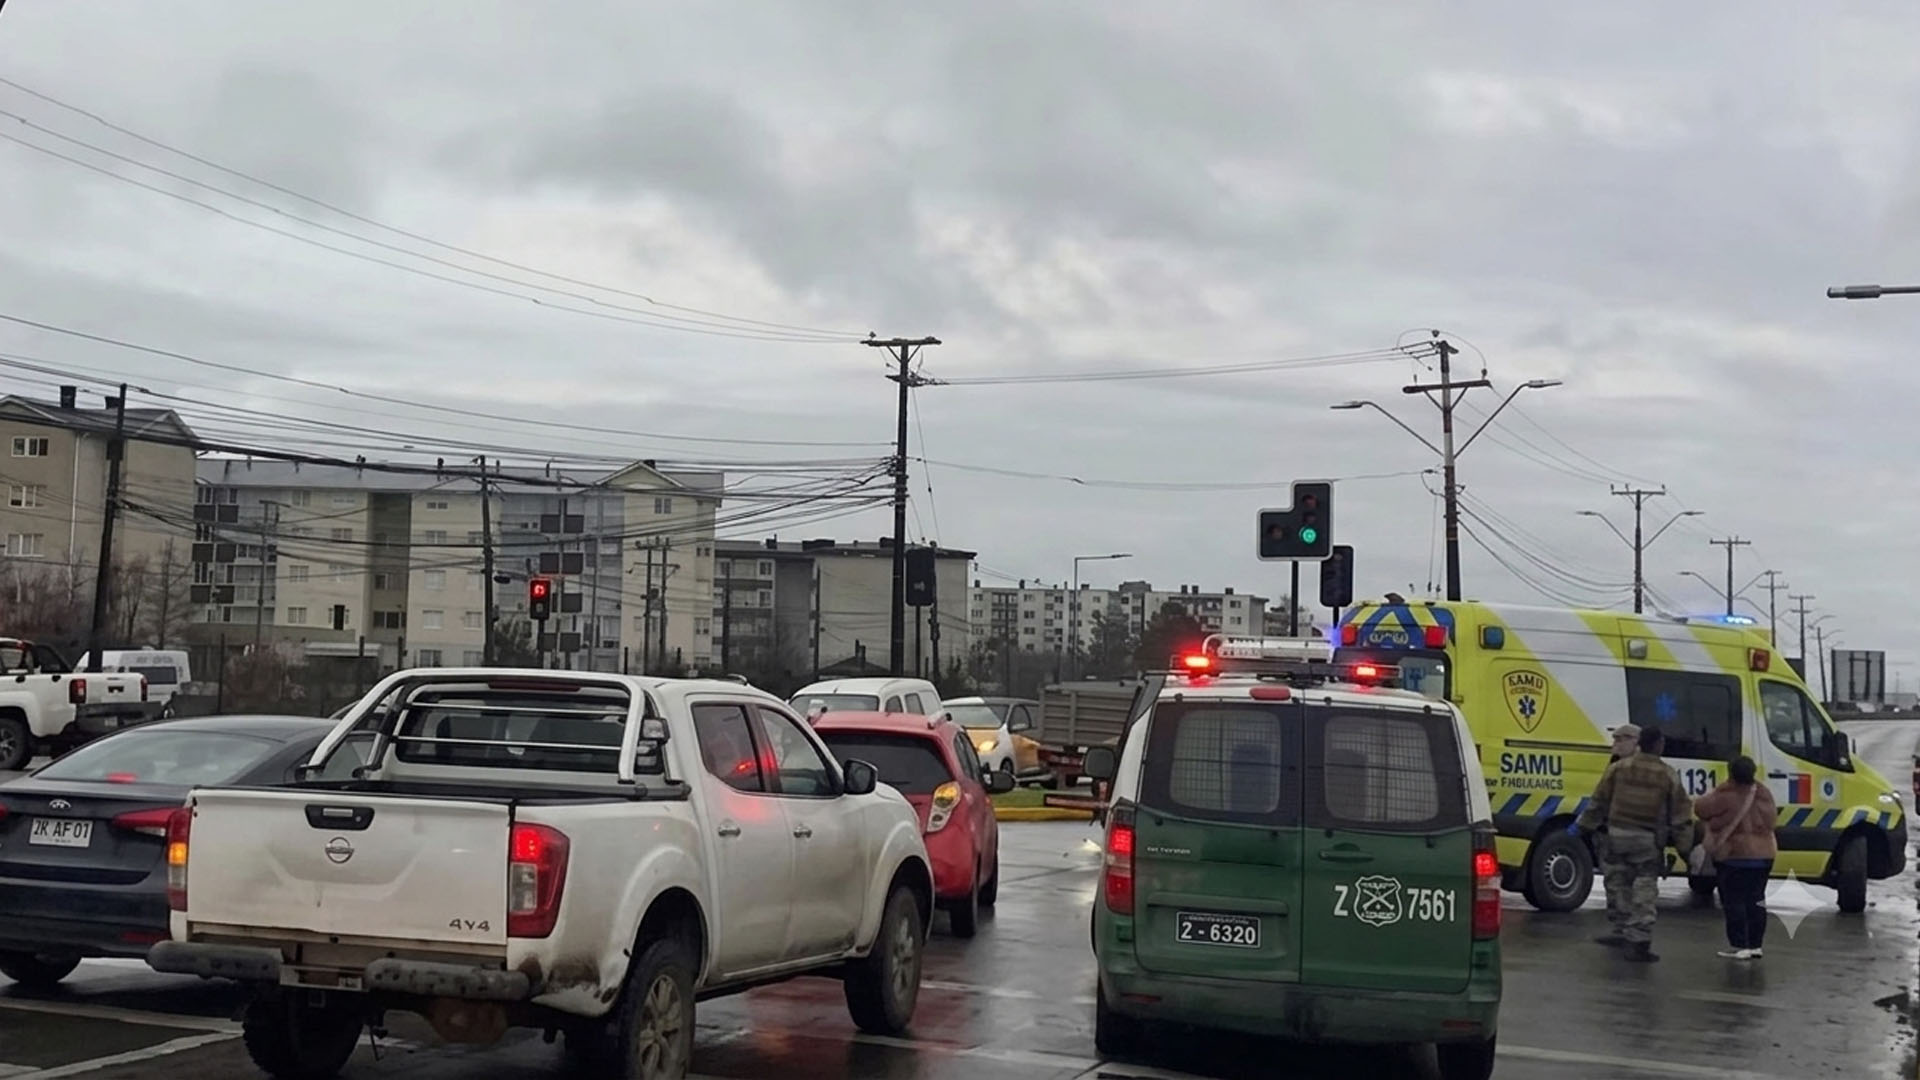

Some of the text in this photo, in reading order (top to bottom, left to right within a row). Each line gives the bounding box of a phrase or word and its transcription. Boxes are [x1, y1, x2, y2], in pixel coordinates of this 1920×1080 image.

[1500, 752, 1562, 776] SAMU
[1686, 768, 1716, 796] 131
[1333, 885, 1456, 922] Z 7561
[1209, 923, 1256, 944] 6320
